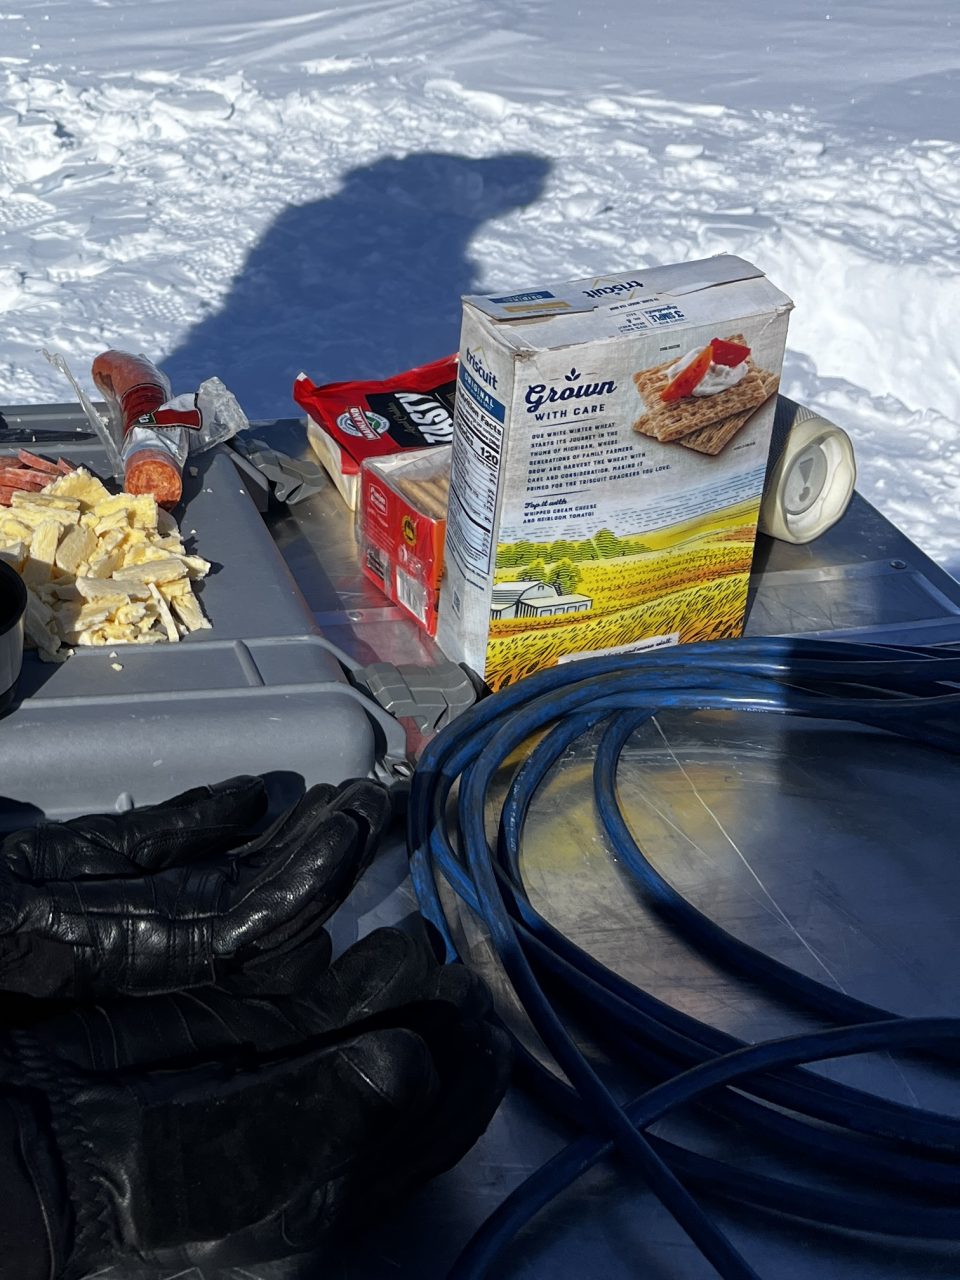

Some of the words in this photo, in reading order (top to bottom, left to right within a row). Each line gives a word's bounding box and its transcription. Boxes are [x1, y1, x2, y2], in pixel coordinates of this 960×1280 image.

[582, 280, 644, 299] triscuit
[466, 347, 498, 390] triscuit
[464, 372, 495, 408] ORIGINAL
[525, 381, 618, 414] Grown
[350, 408, 376, 440] MAINLAND
[394, 393, 454, 444] TASTY
[481, 415, 502, 436] Facts
[534, 409, 567, 421] WITH
[574, 404, 606, 416] CARE
[481, 447, 498, 466] 120
[525, 502, 540, 510] Top
